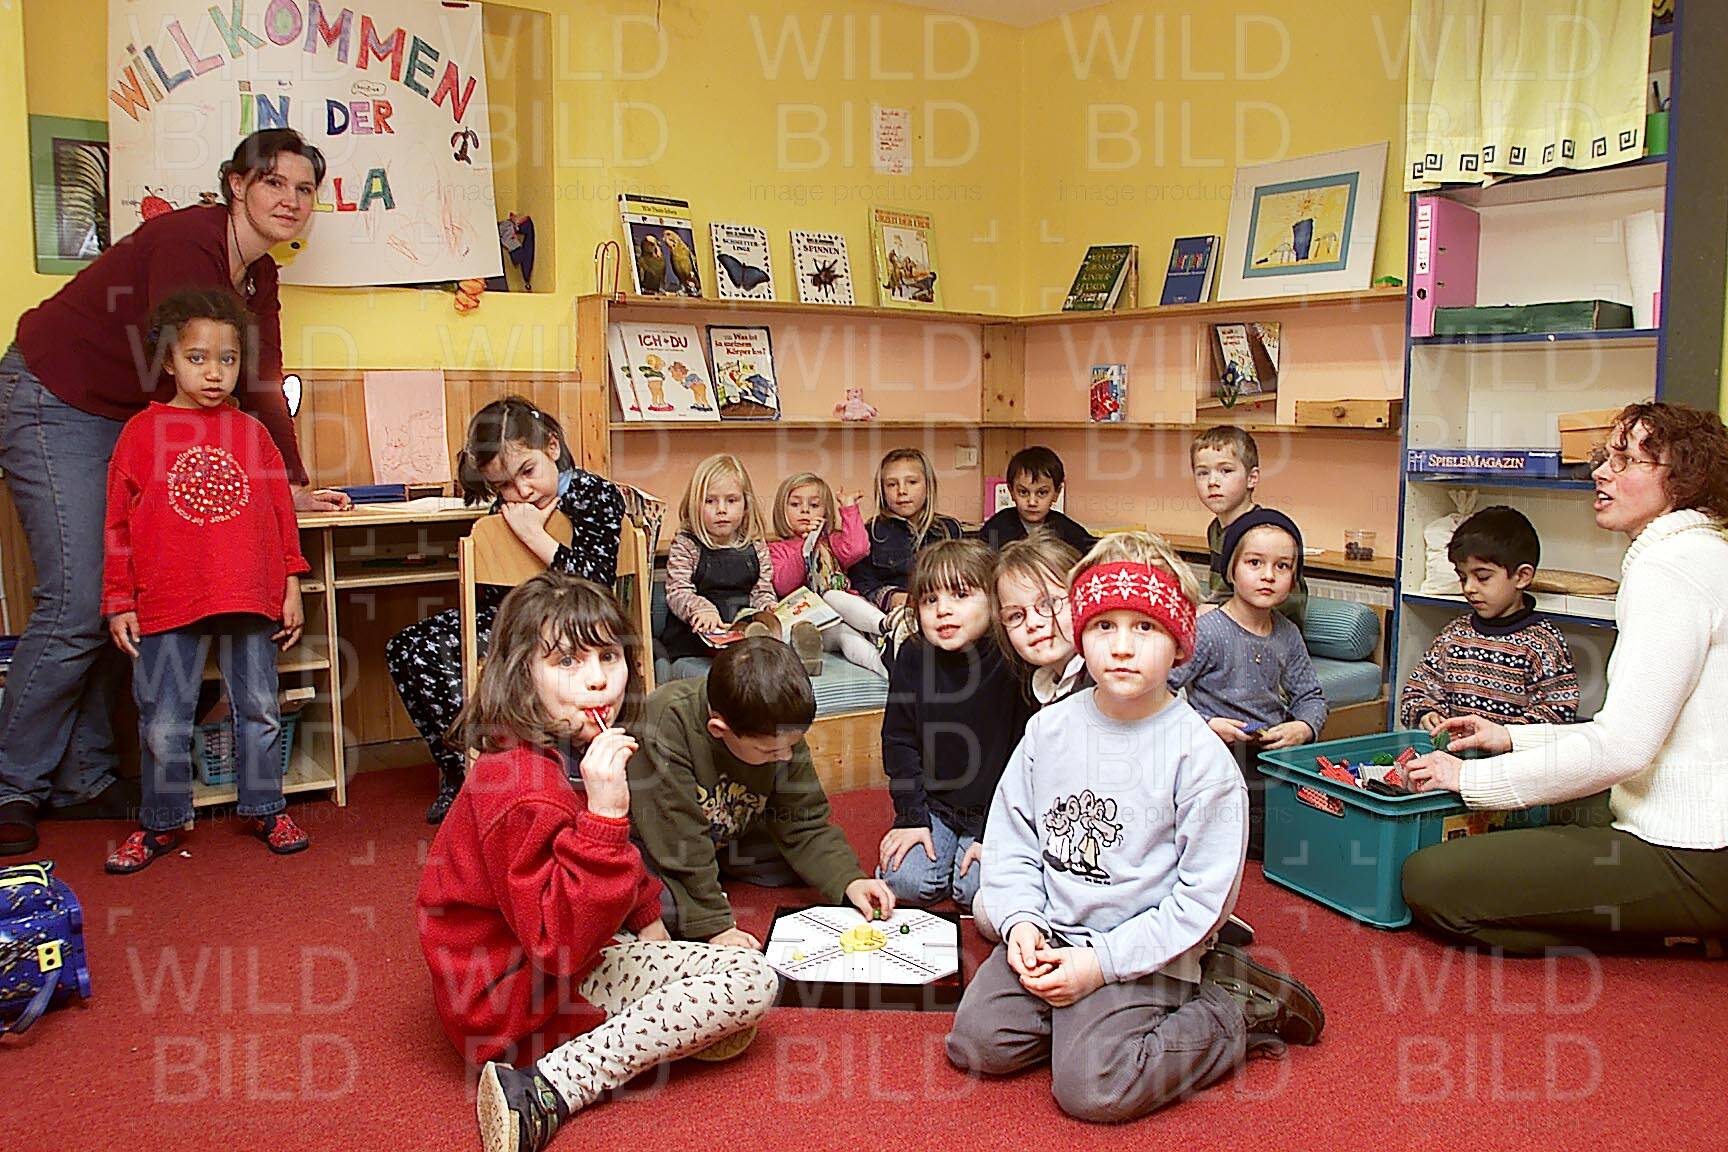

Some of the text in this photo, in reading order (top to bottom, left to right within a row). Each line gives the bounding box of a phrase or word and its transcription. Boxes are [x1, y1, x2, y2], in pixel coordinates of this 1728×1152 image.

[326, 98, 394, 135] DER
[637, 334, 662, 347] ICH
[670, 335, 688, 348] DU
